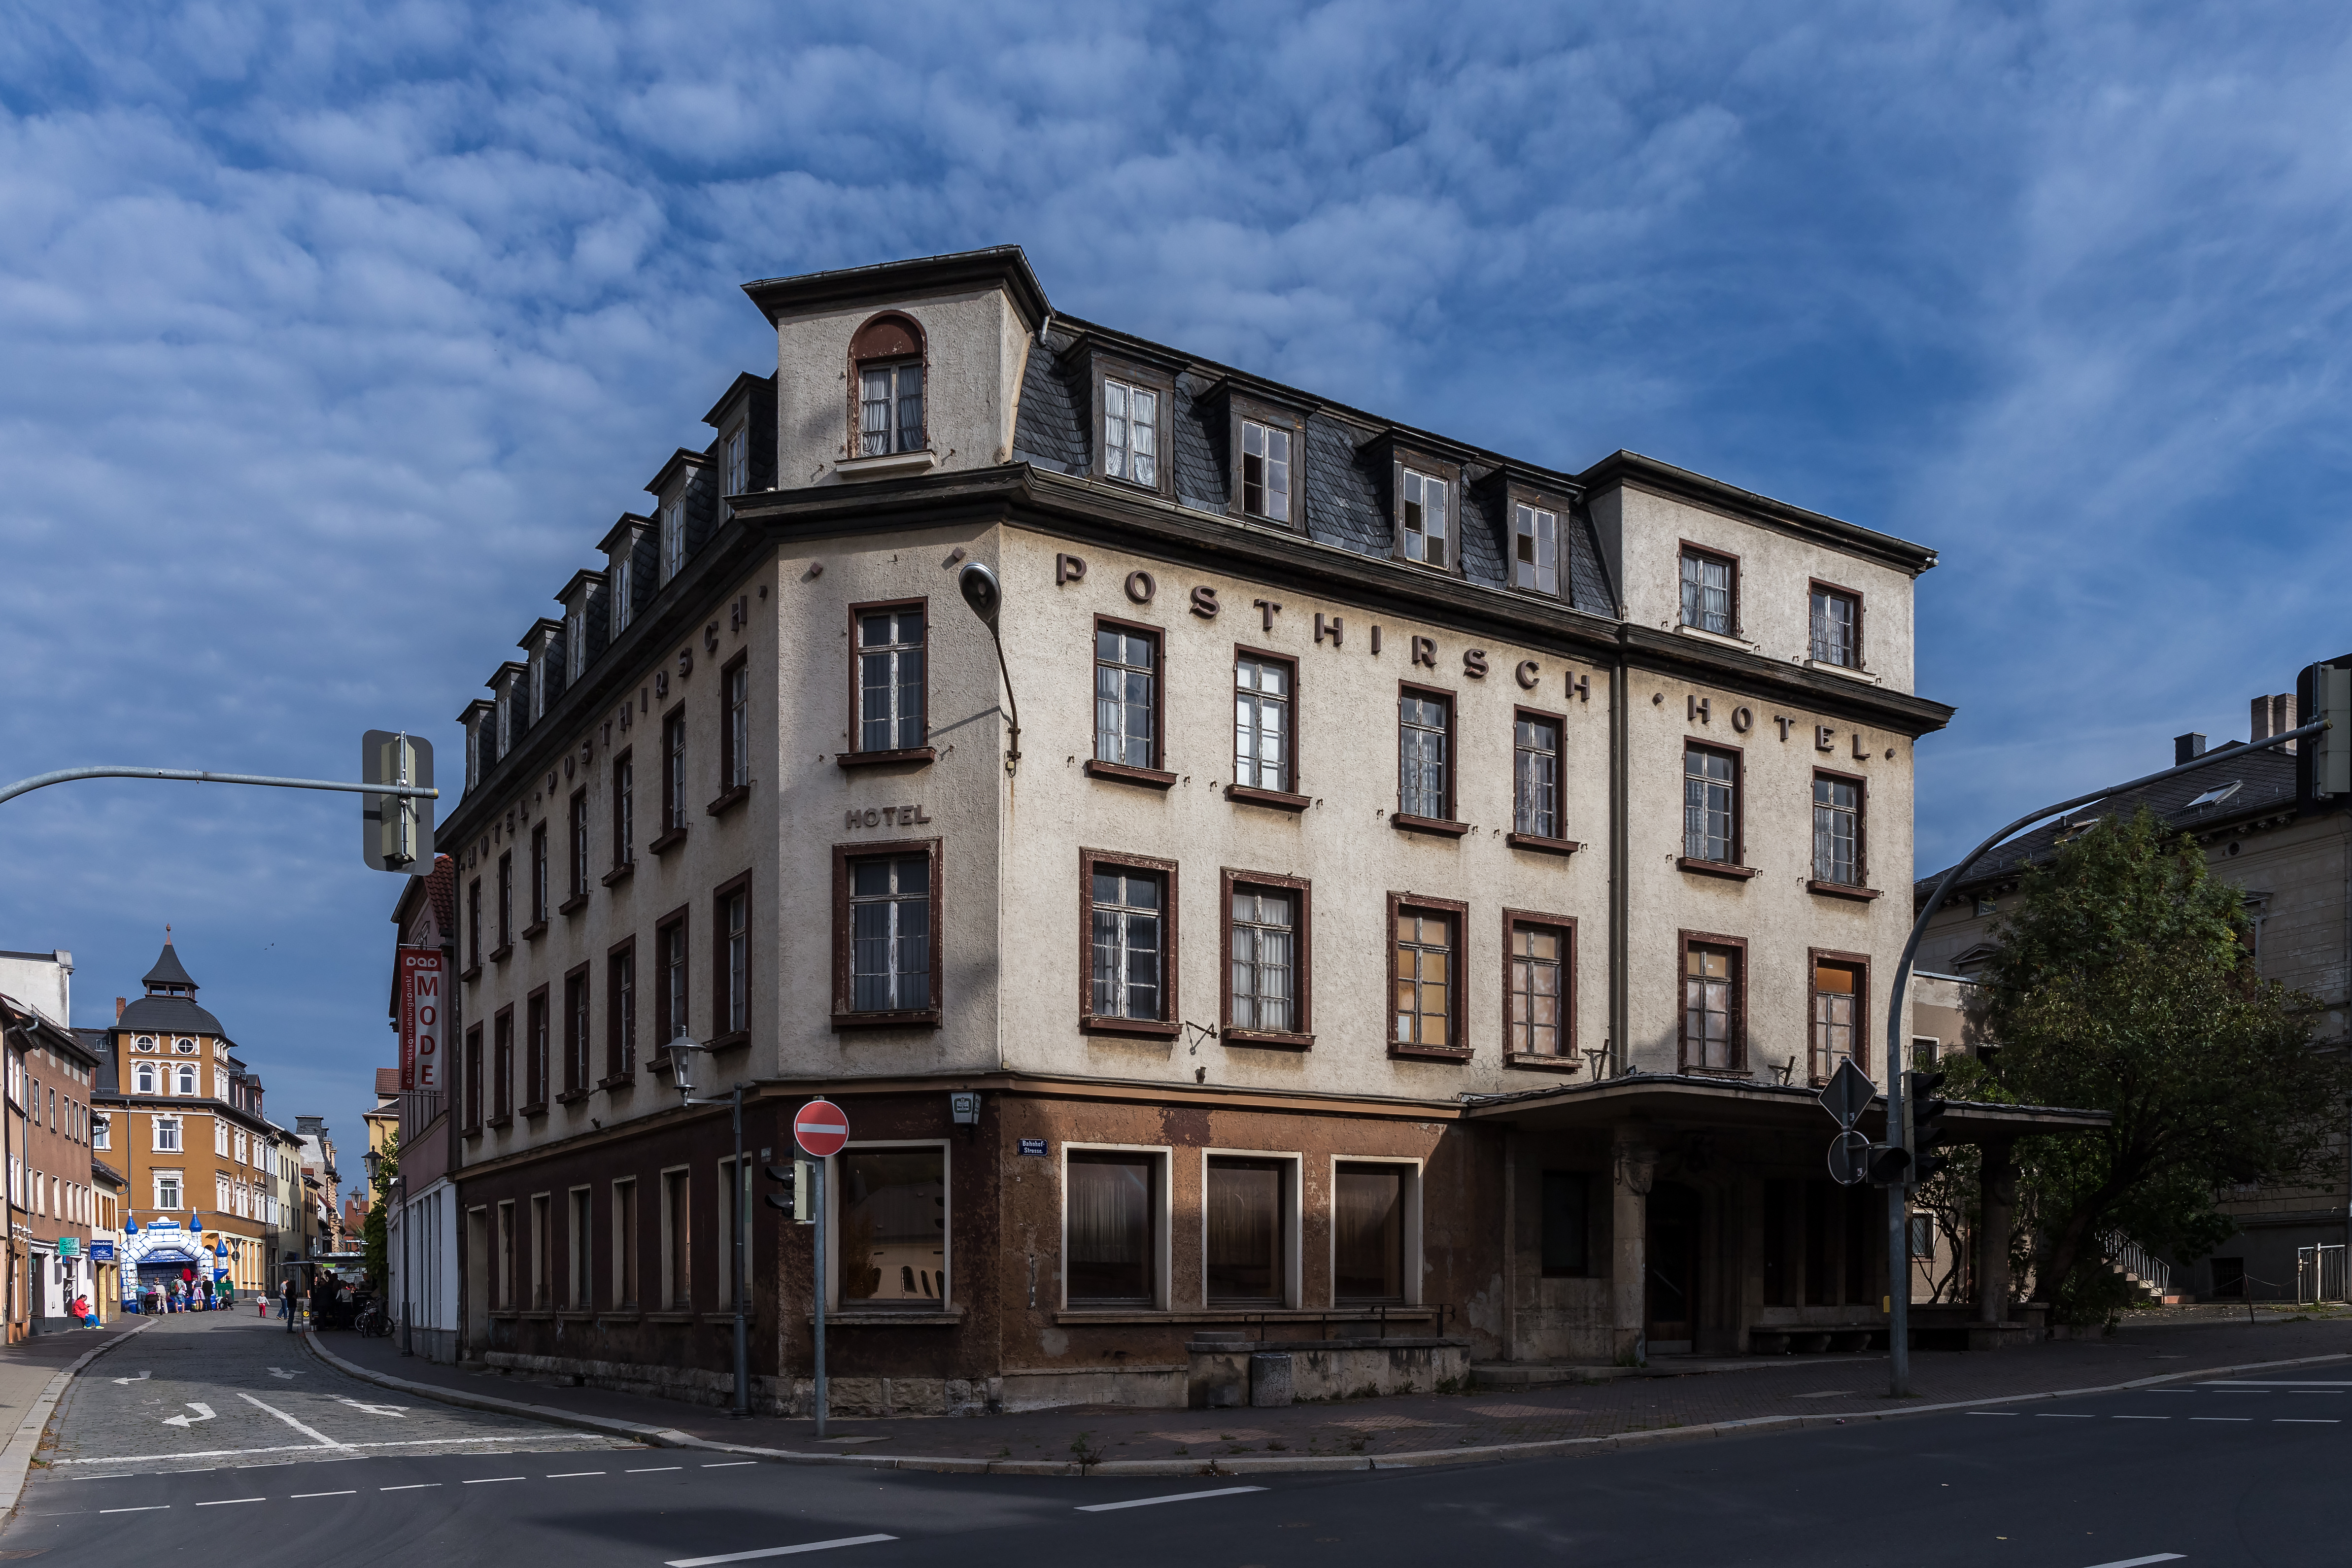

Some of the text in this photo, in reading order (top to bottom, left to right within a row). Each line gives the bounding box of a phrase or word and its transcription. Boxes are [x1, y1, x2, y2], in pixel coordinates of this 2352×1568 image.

[468, 595, 748, 868] HOTEL POSTHIRSCH
[1057, 552, 1871, 760] POSTHIRSCH HOTEL
[846, 804, 931, 828] HOTEL
[417, 976, 438, 1085] MODE
